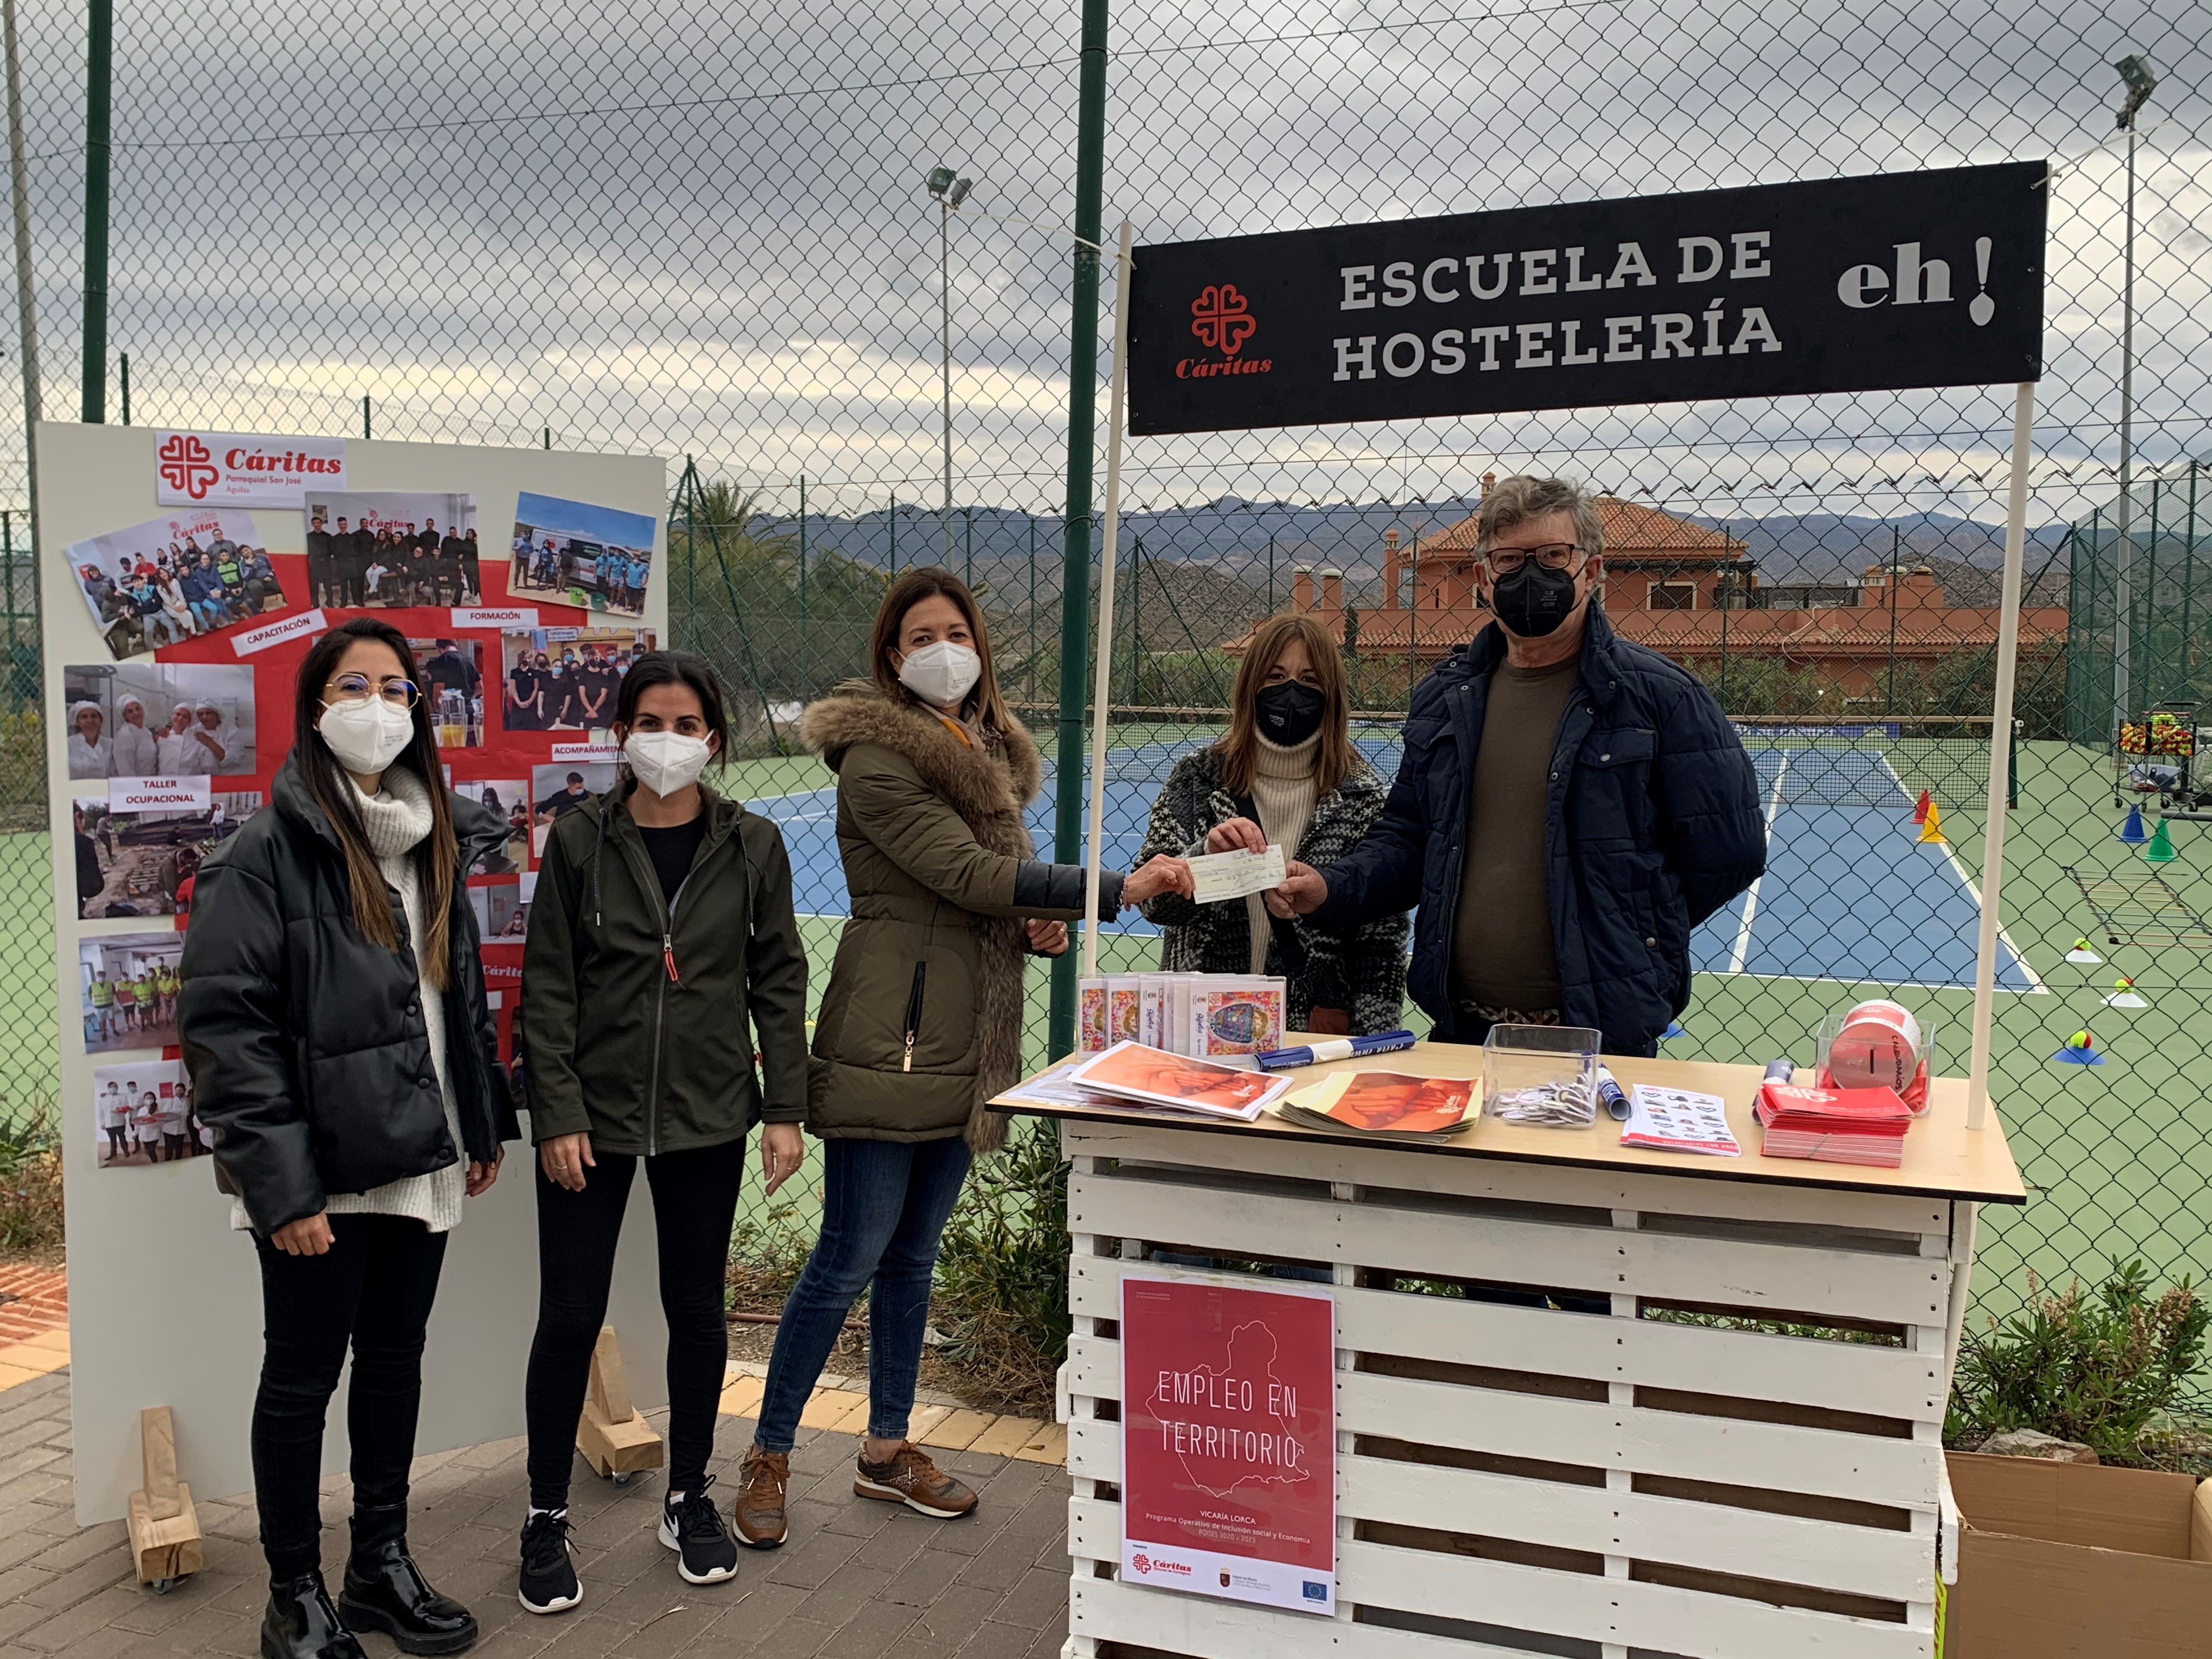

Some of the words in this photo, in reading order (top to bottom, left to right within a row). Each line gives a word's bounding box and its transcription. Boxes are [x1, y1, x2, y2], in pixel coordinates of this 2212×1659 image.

[1340, 241, 1656, 311] ESCUELA
[1677, 231, 1771, 284] DE
[1837, 236, 1995, 326] eh!
[1333, 298, 1782, 381] HOSTELERÍA
[1175, 353, 1272, 379] Cáritas
[225, 448, 341, 474] Cáritas
[225, 475, 267, 484] Parroquial
[285, 476, 302, 486] José
[173, 521, 219, 539] Cáritas
[470, 611, 521, 621] FORMACIÓN
[247, 617, 311, 645] CAPACITACIÓN
[554, 745, 620, 754] ACOMPAÑAMIEN
[143, 780, 177, 788] TALLER
[126, 794, 195, 804] OCUPACIONAL
[483, 964, 522, 978] Cárita
[1159, 1371, 1252, 1412] EMPLEO
[1268, 1384, 1296, 1418] EN
[1160, 1420, 1296, 1468] TERRITORIO
[1200, 1510, 1229, 1521] VICARÍA
[1230, 1515, 1256, 1525] LORCA
[1146, 1513, 1177, 1523] Programa
[1178, 1517, 1210, 1528] Operativo
[1222, 1525, 1251, 1534] Inclusión
[1252, 1529, 1271, 1537] social
[1278, 1532, 1310, 1544] Economía
[1220, 1533, 1234, 1541] 2020
[1153, 1560, 1192, 1572] Cáritas
